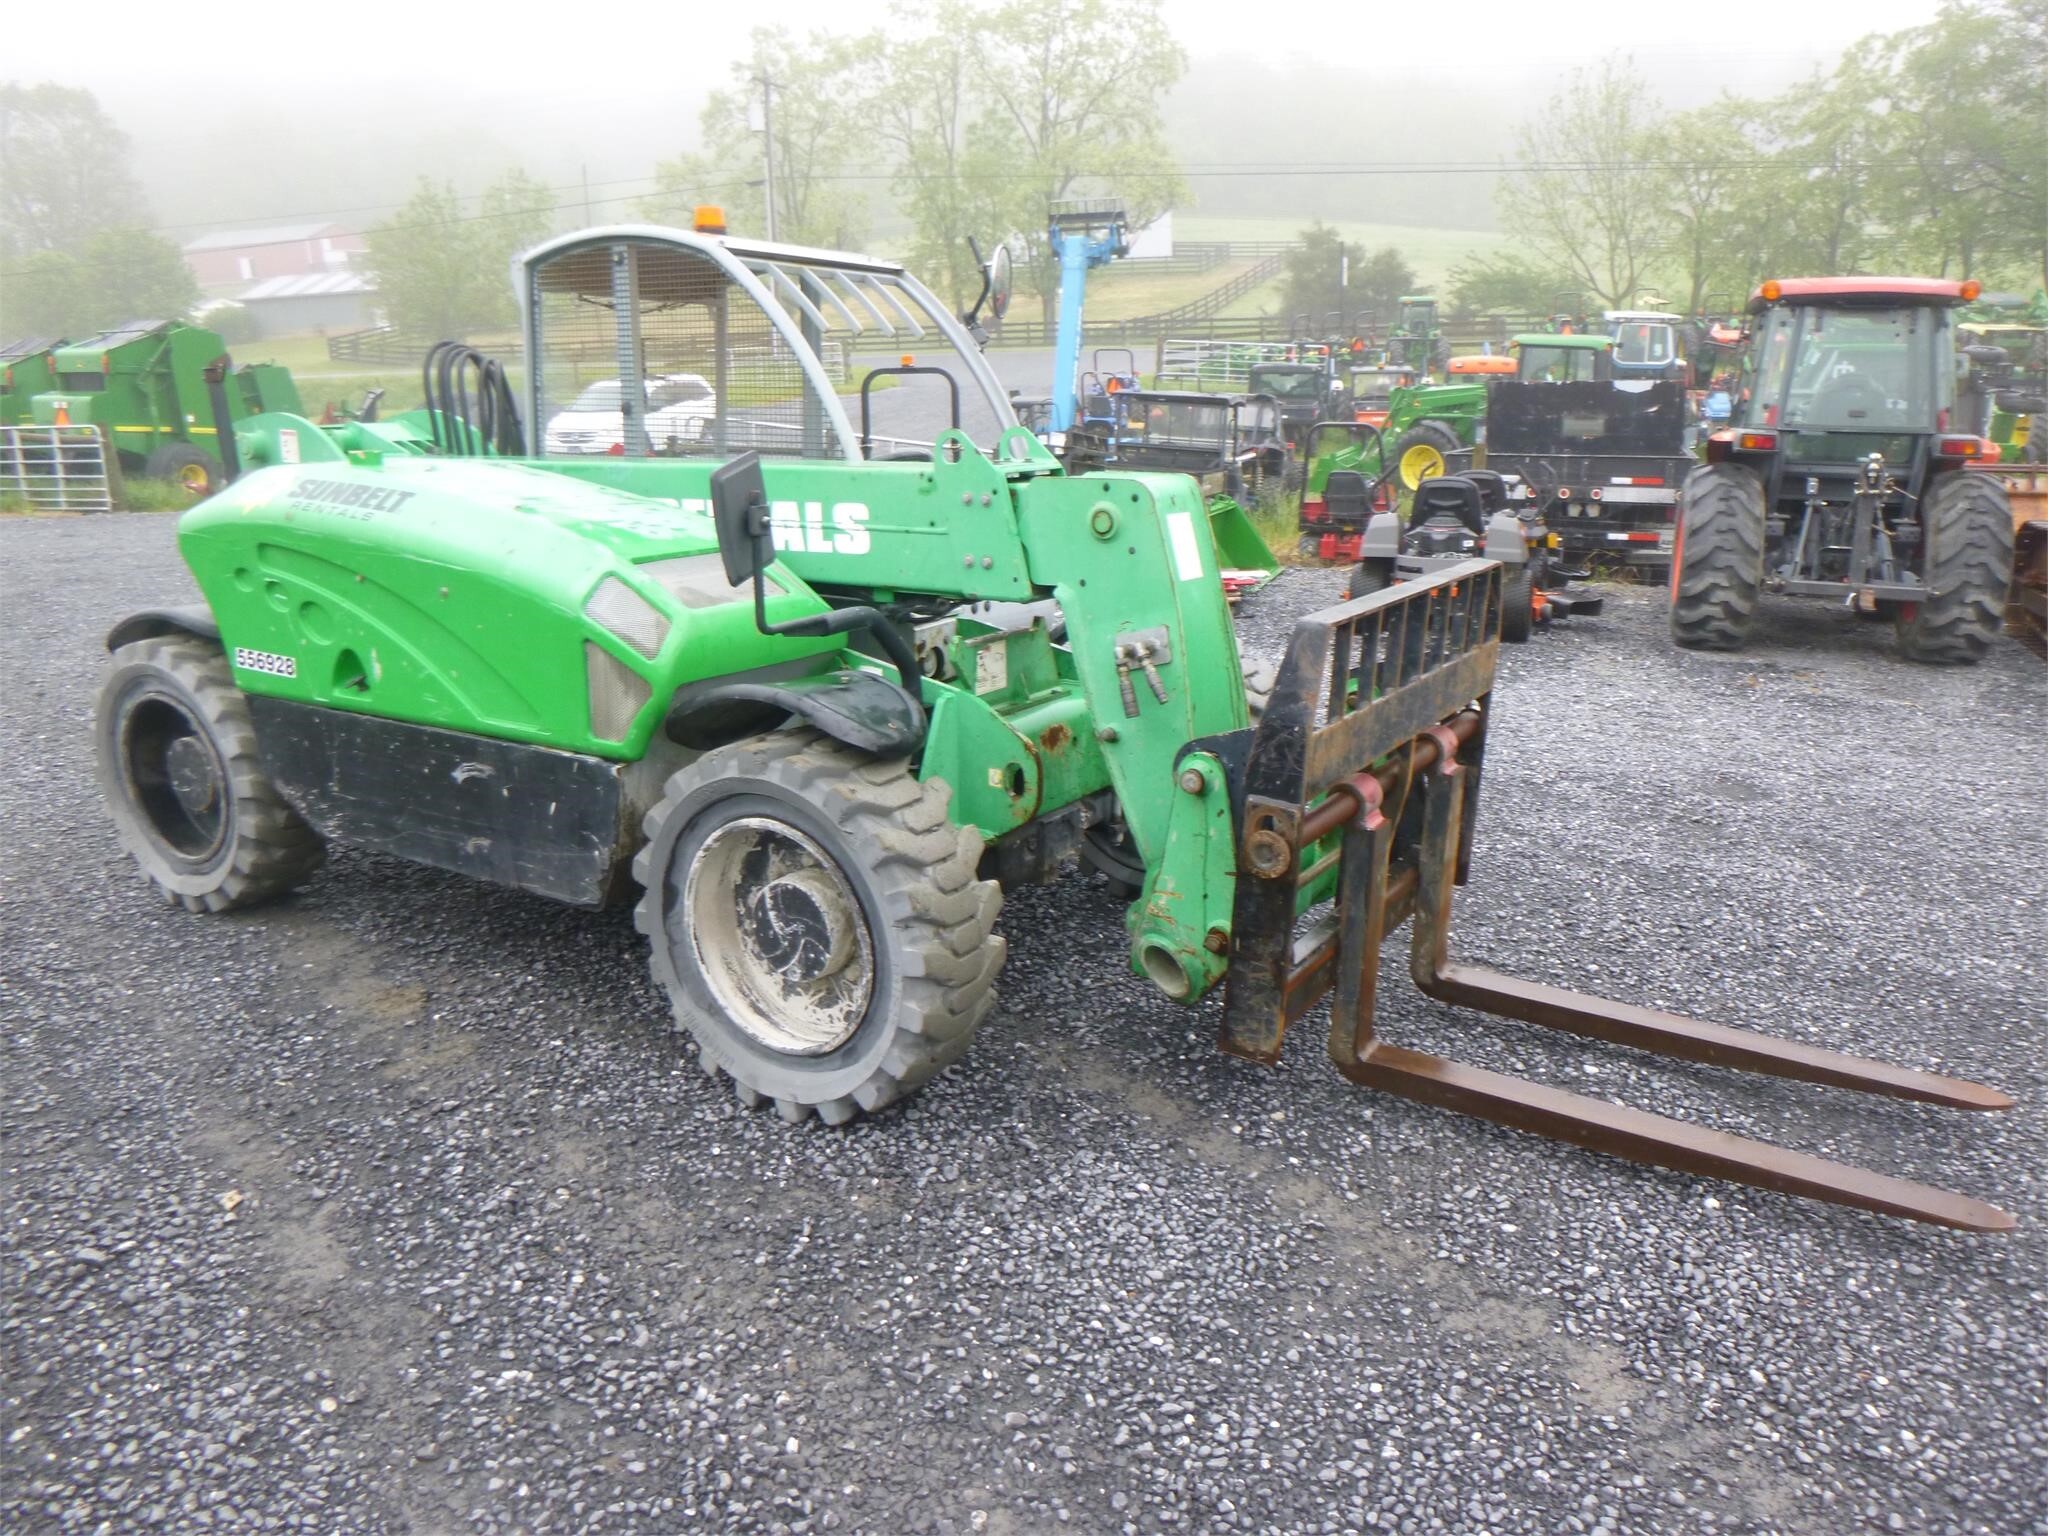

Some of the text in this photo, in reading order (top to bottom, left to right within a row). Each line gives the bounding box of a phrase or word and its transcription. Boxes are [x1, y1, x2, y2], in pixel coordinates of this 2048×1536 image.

[288, 479, 416, 513] SUNBELT
[289, 501, 376, 522] RENTALS
[767, 500, 871, 555] ALS
[237, 648, 295, 676] 556928
